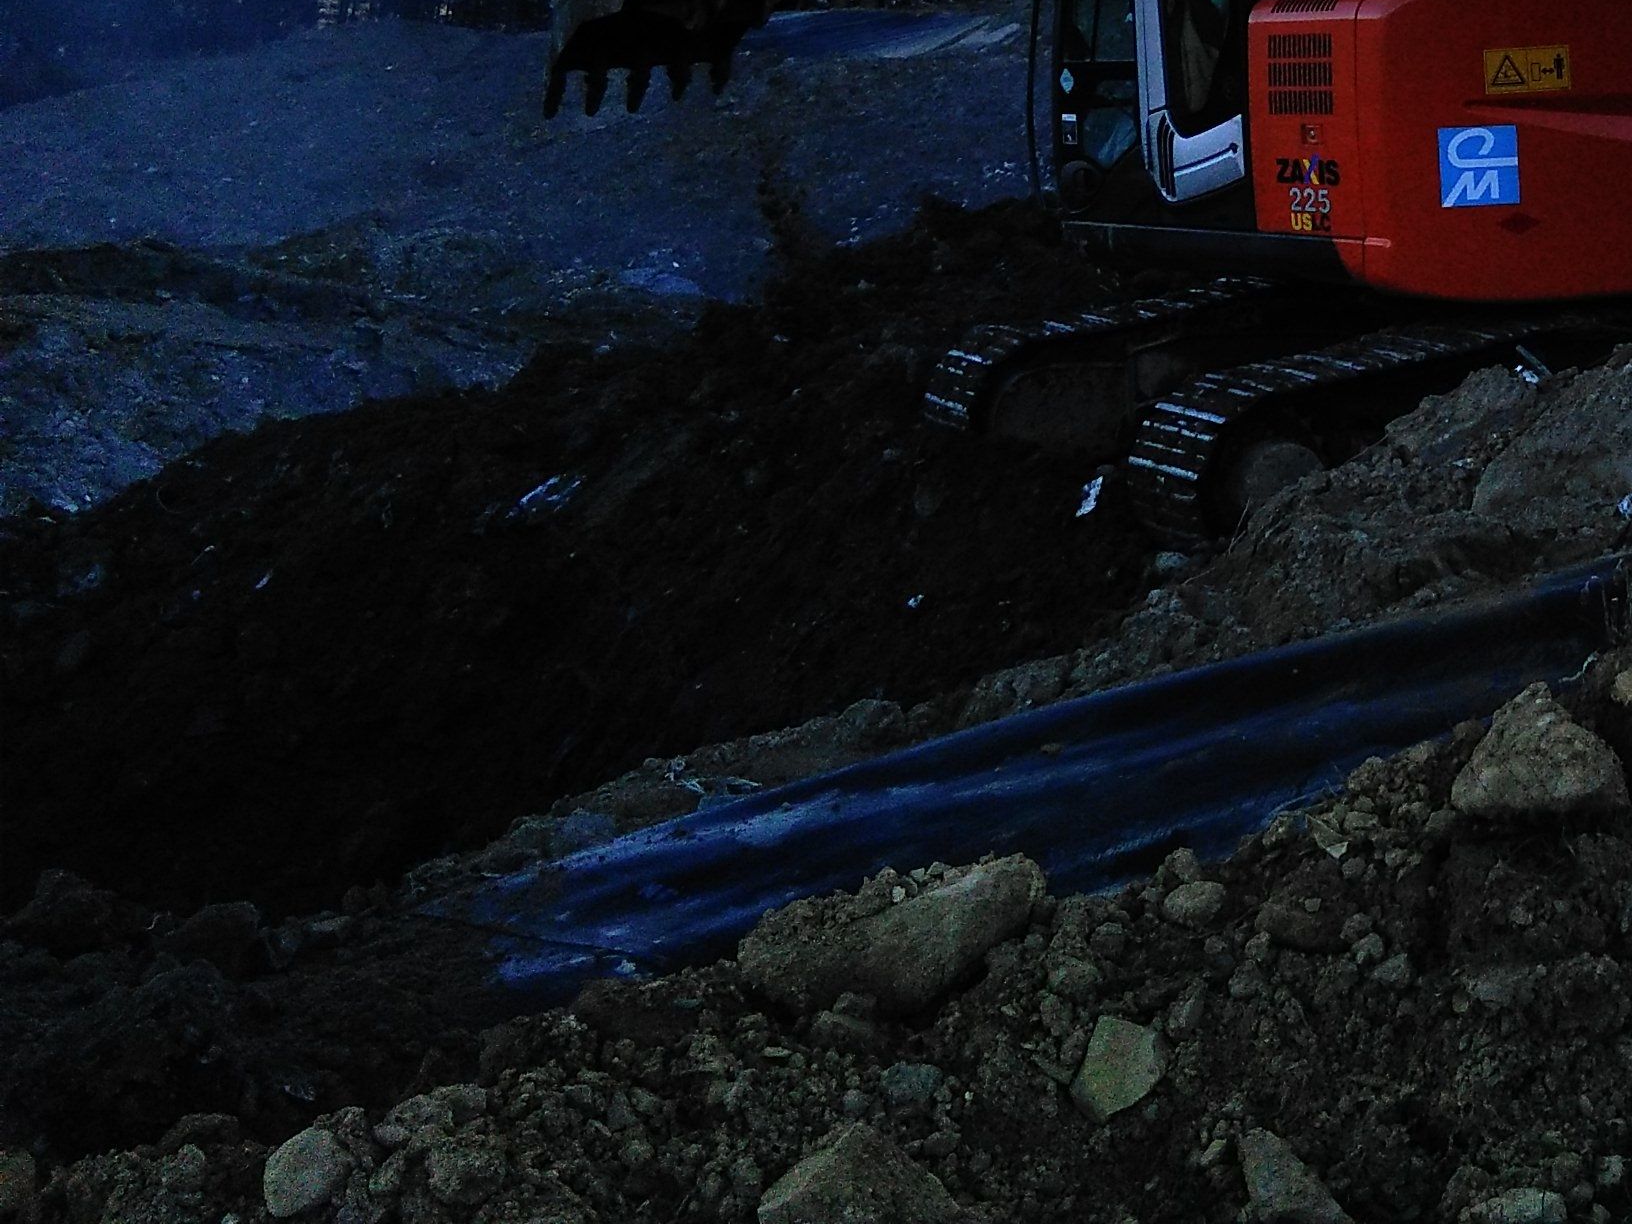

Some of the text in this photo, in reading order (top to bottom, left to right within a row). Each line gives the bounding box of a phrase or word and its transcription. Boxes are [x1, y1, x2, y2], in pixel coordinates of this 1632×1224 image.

[1276, 153, 1341, 187] ZAXIS
[1289, 187, 1332, 214] 225
[1290, 212, 1332, 231] USLC
